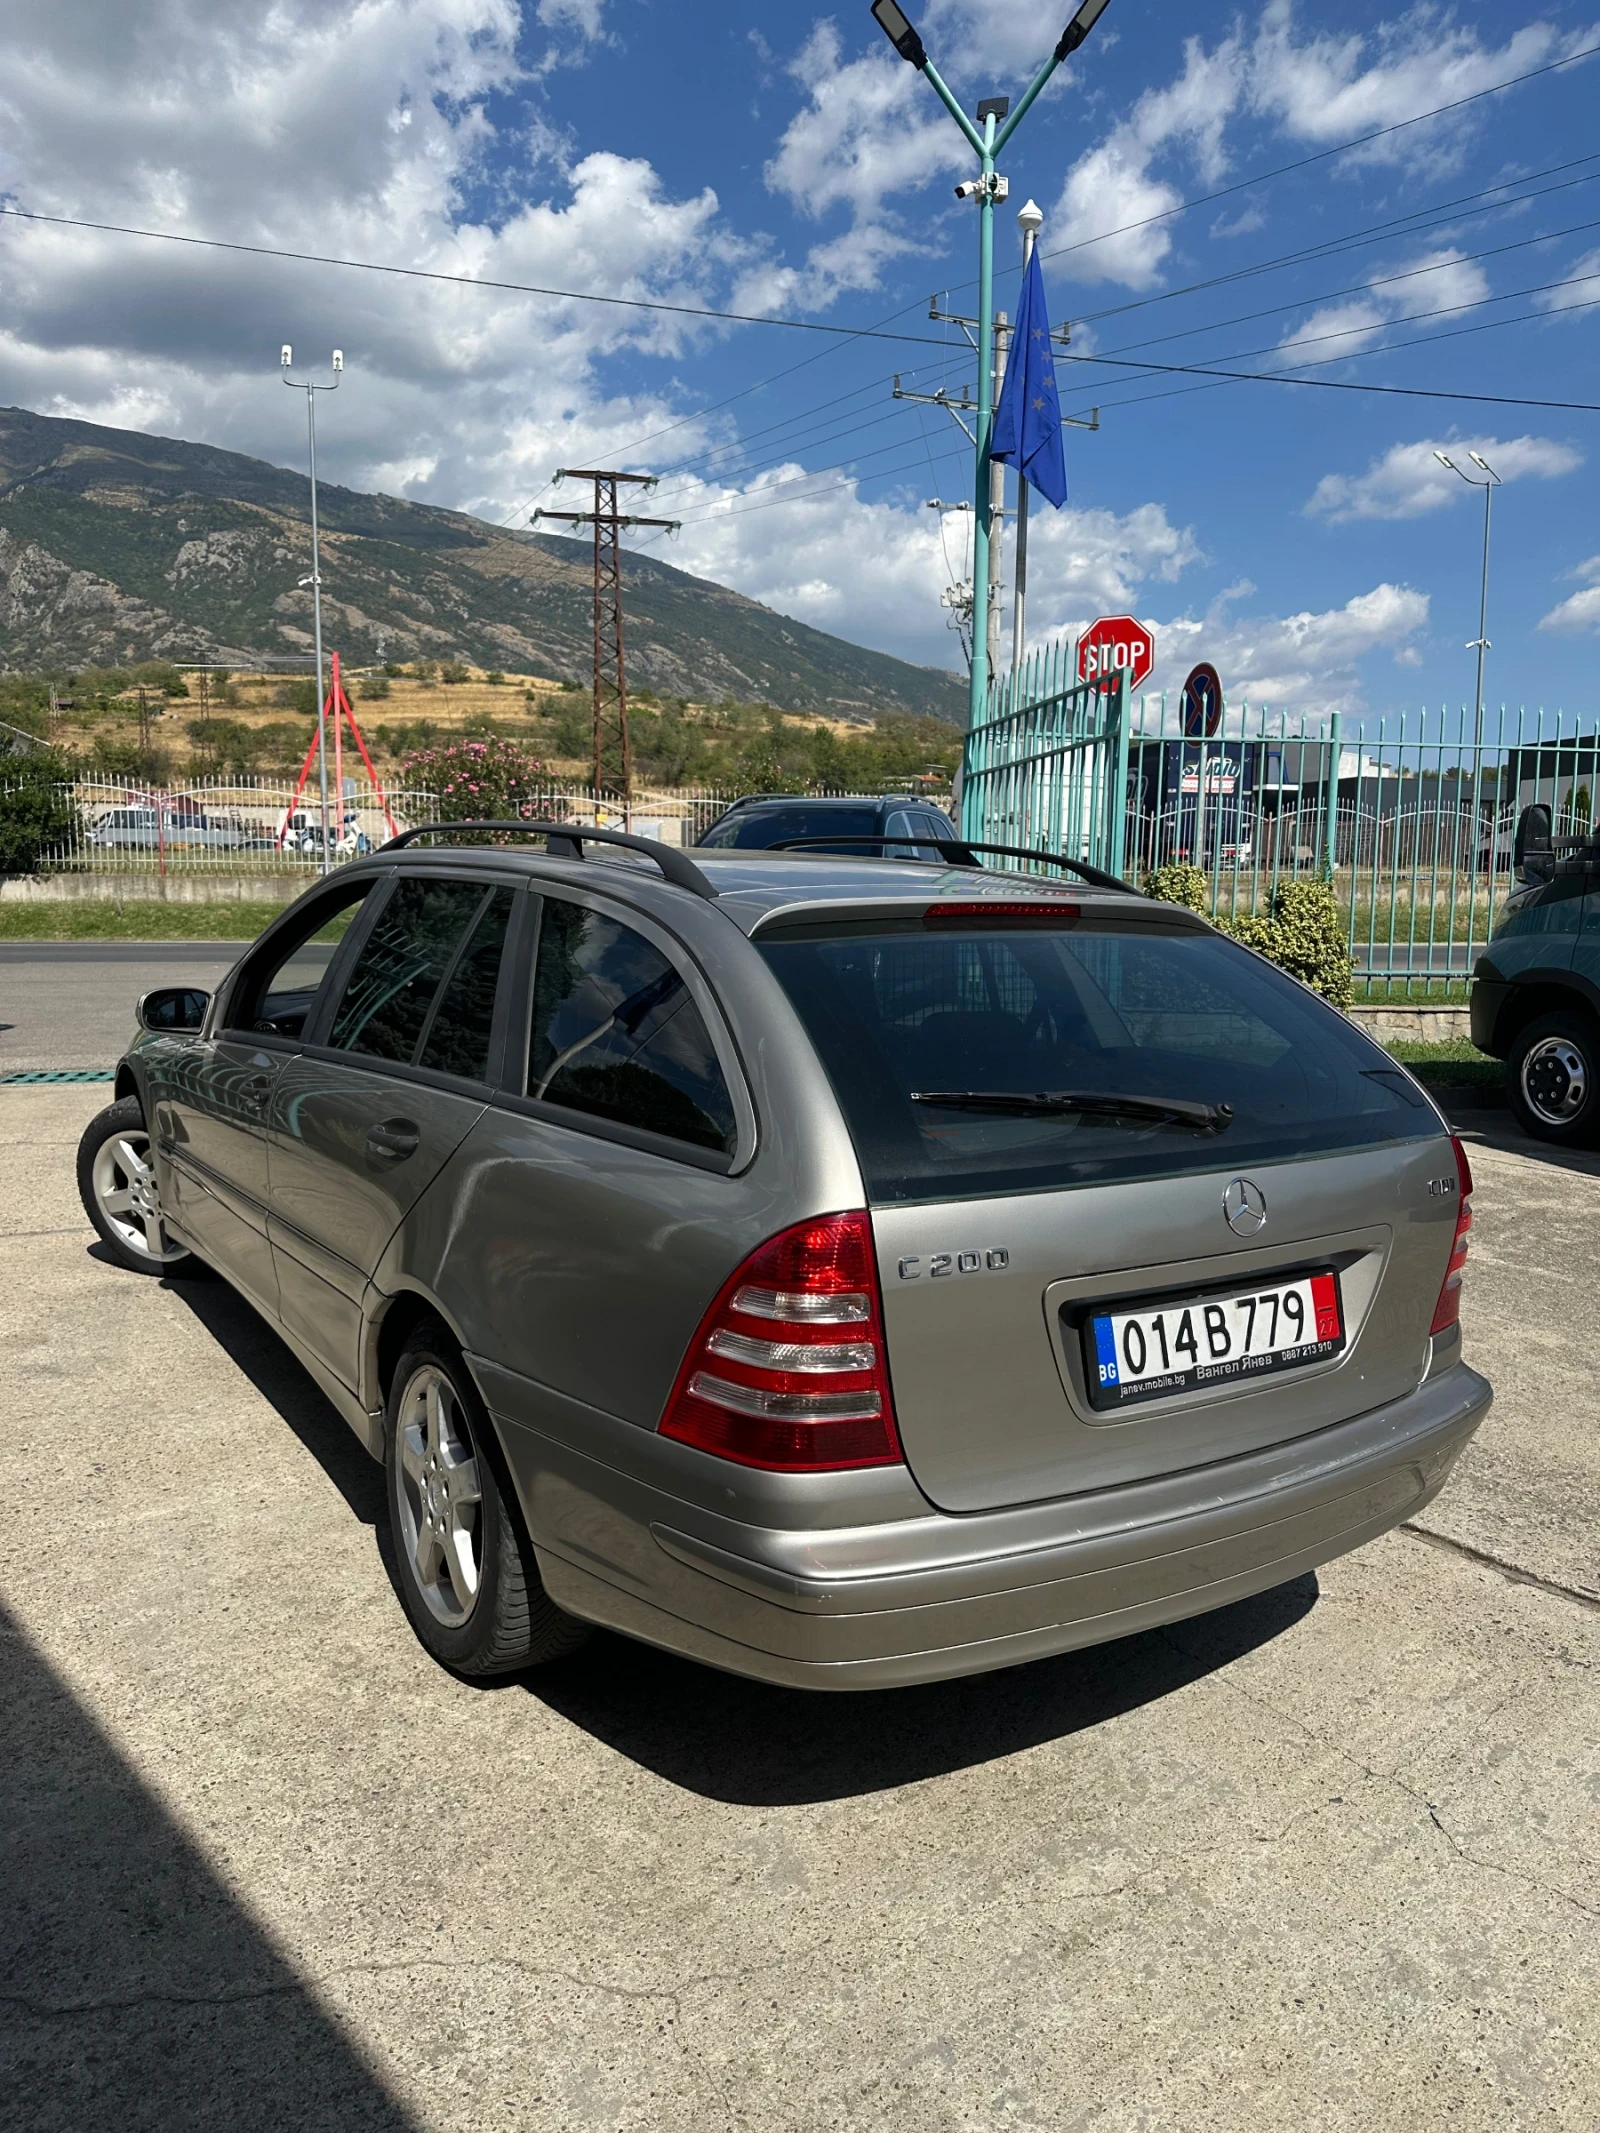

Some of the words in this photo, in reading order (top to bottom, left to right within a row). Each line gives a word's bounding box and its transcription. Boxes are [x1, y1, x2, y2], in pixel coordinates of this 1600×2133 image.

[1084, 641, 1145, 671] STOP
[898, 1256, 920, 1279] C
[930, 1247, 1009, 1278] 200
[1281, 1349, 1300, 1361] 0887
[1302, 1345, 1317, 1357] 213
[1318, 1341, 1332, 1352] 910
[1099, 1362, 1117, 1381] BG
[1196, 1361, 1239, 1380] Вангел
[1242, 1355, 1273, 1371] Янев
[1120, 1374, 1186, 1398] janev.mobile.bg
